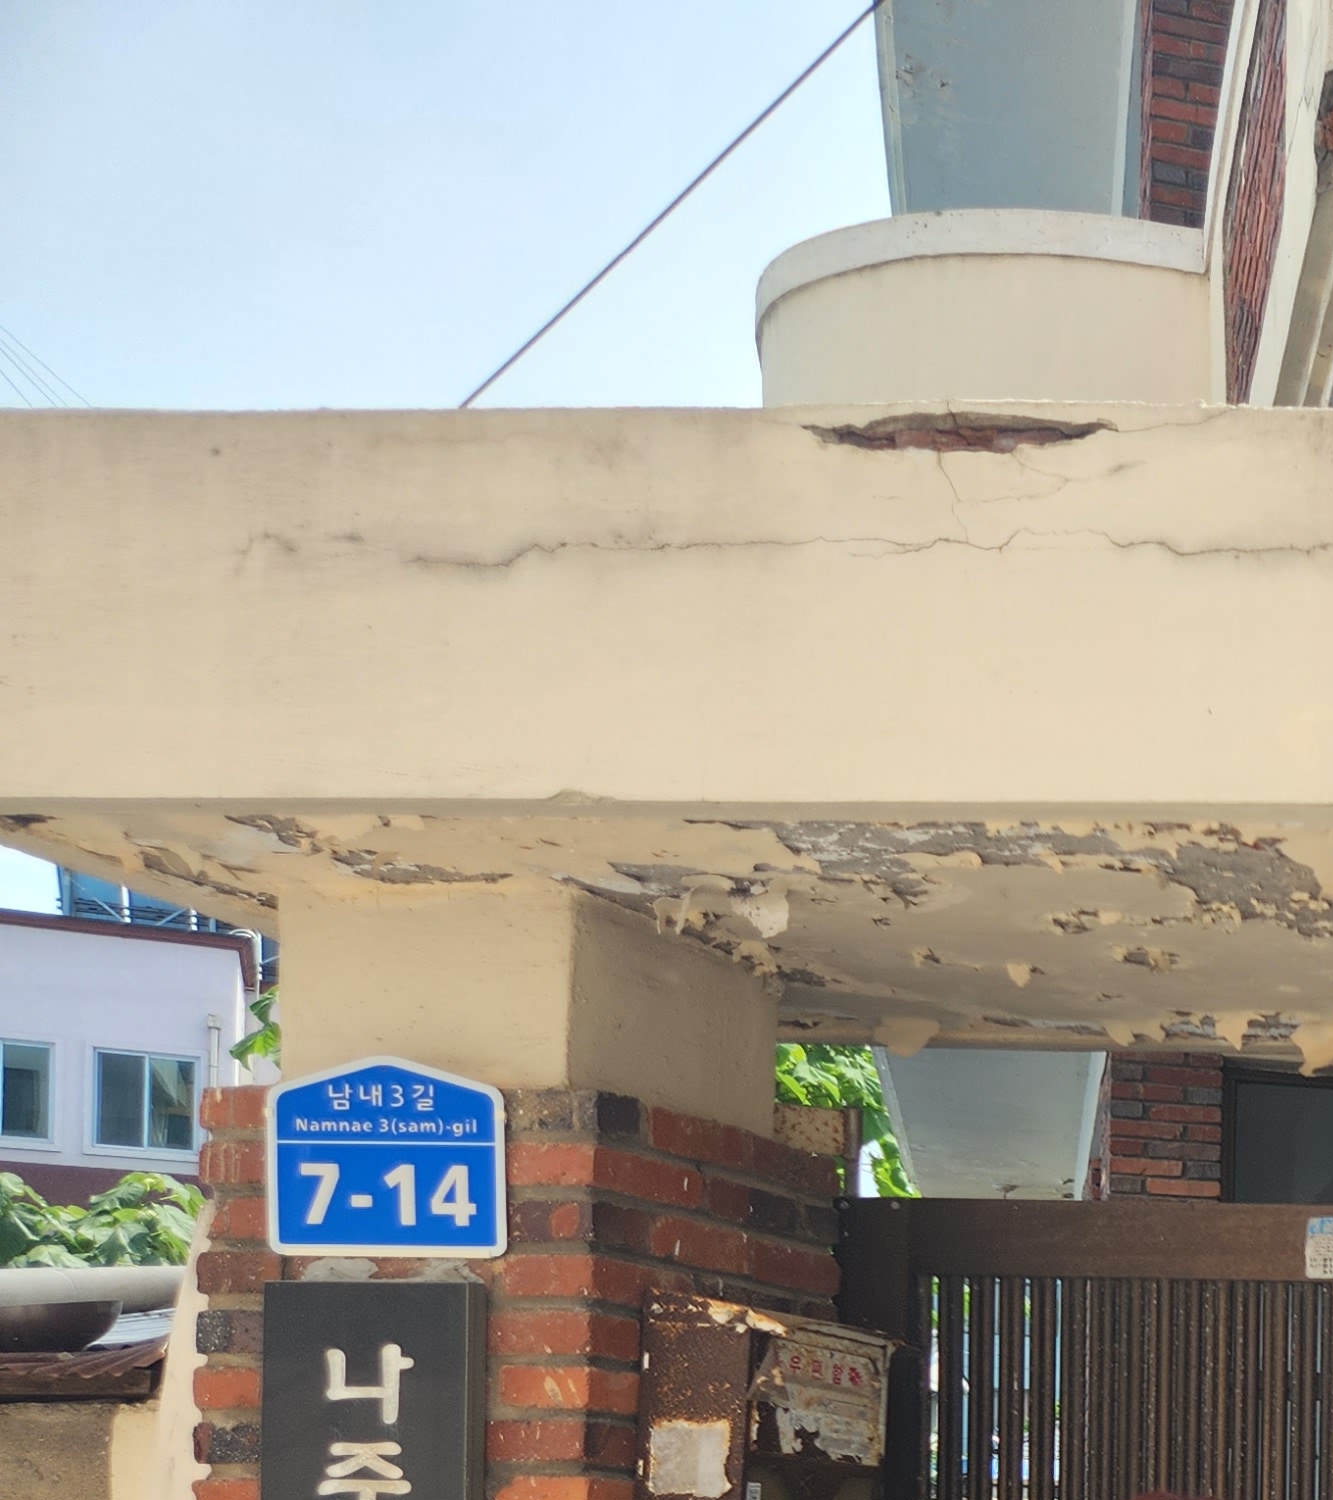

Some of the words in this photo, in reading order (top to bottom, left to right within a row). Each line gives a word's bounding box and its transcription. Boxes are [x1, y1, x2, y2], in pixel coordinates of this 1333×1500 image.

[328, 1084, 435, 1111] 남내3길
[295, 1118, 373, 1133] Namnae
[379, 1118, 477, 1137] 3(sam)-gil
[300, 1163, 477, 1227] 7-14
